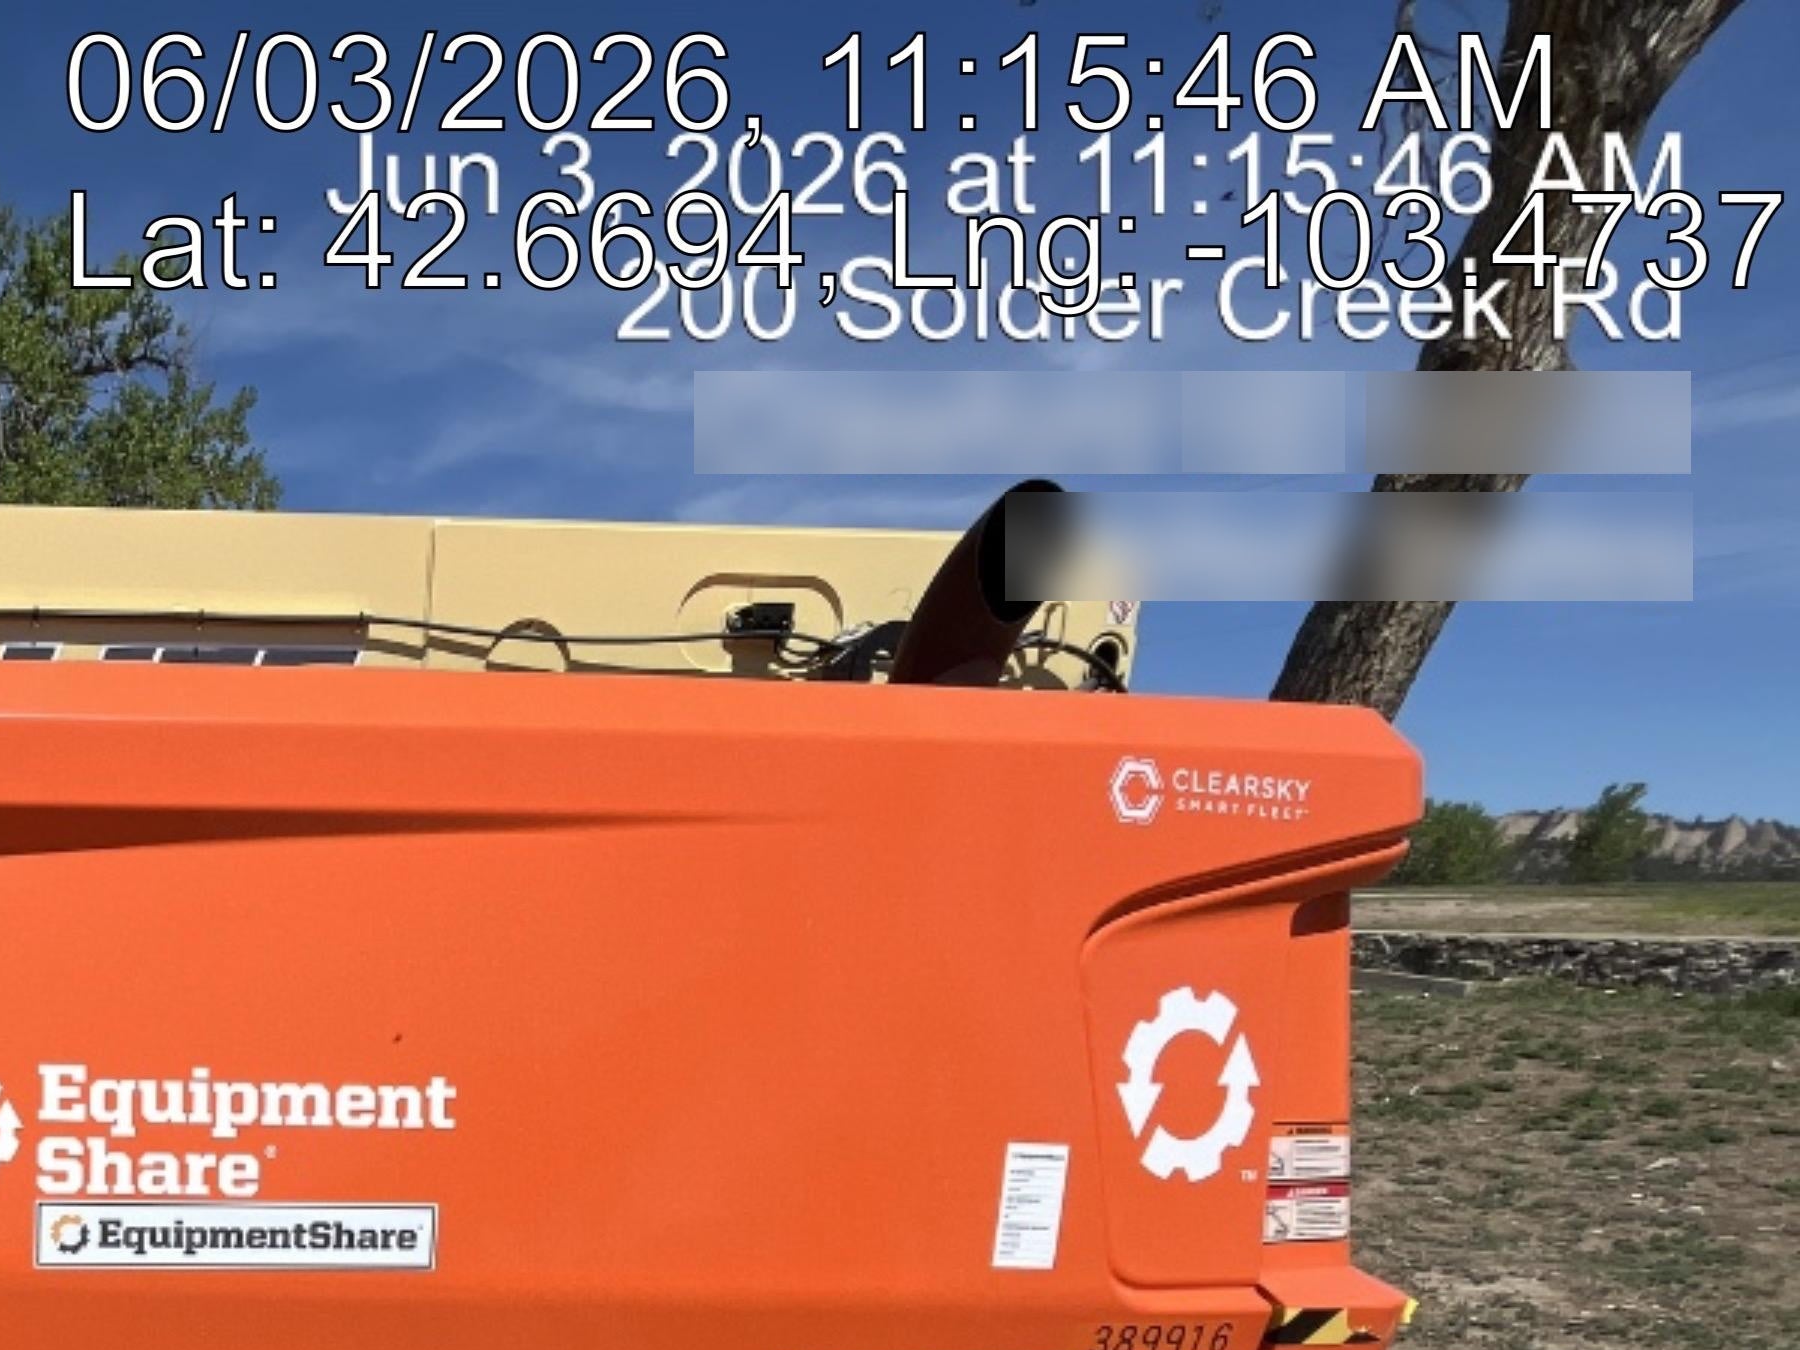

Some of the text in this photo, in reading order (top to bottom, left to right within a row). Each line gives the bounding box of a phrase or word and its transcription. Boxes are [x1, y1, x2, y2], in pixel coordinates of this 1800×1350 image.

[1172, 768, 1312, 802] CLEARSKY
[37, 1063, 457, 1137] Equipment
[98, 1219, 419, 1255] EquipmentShare
